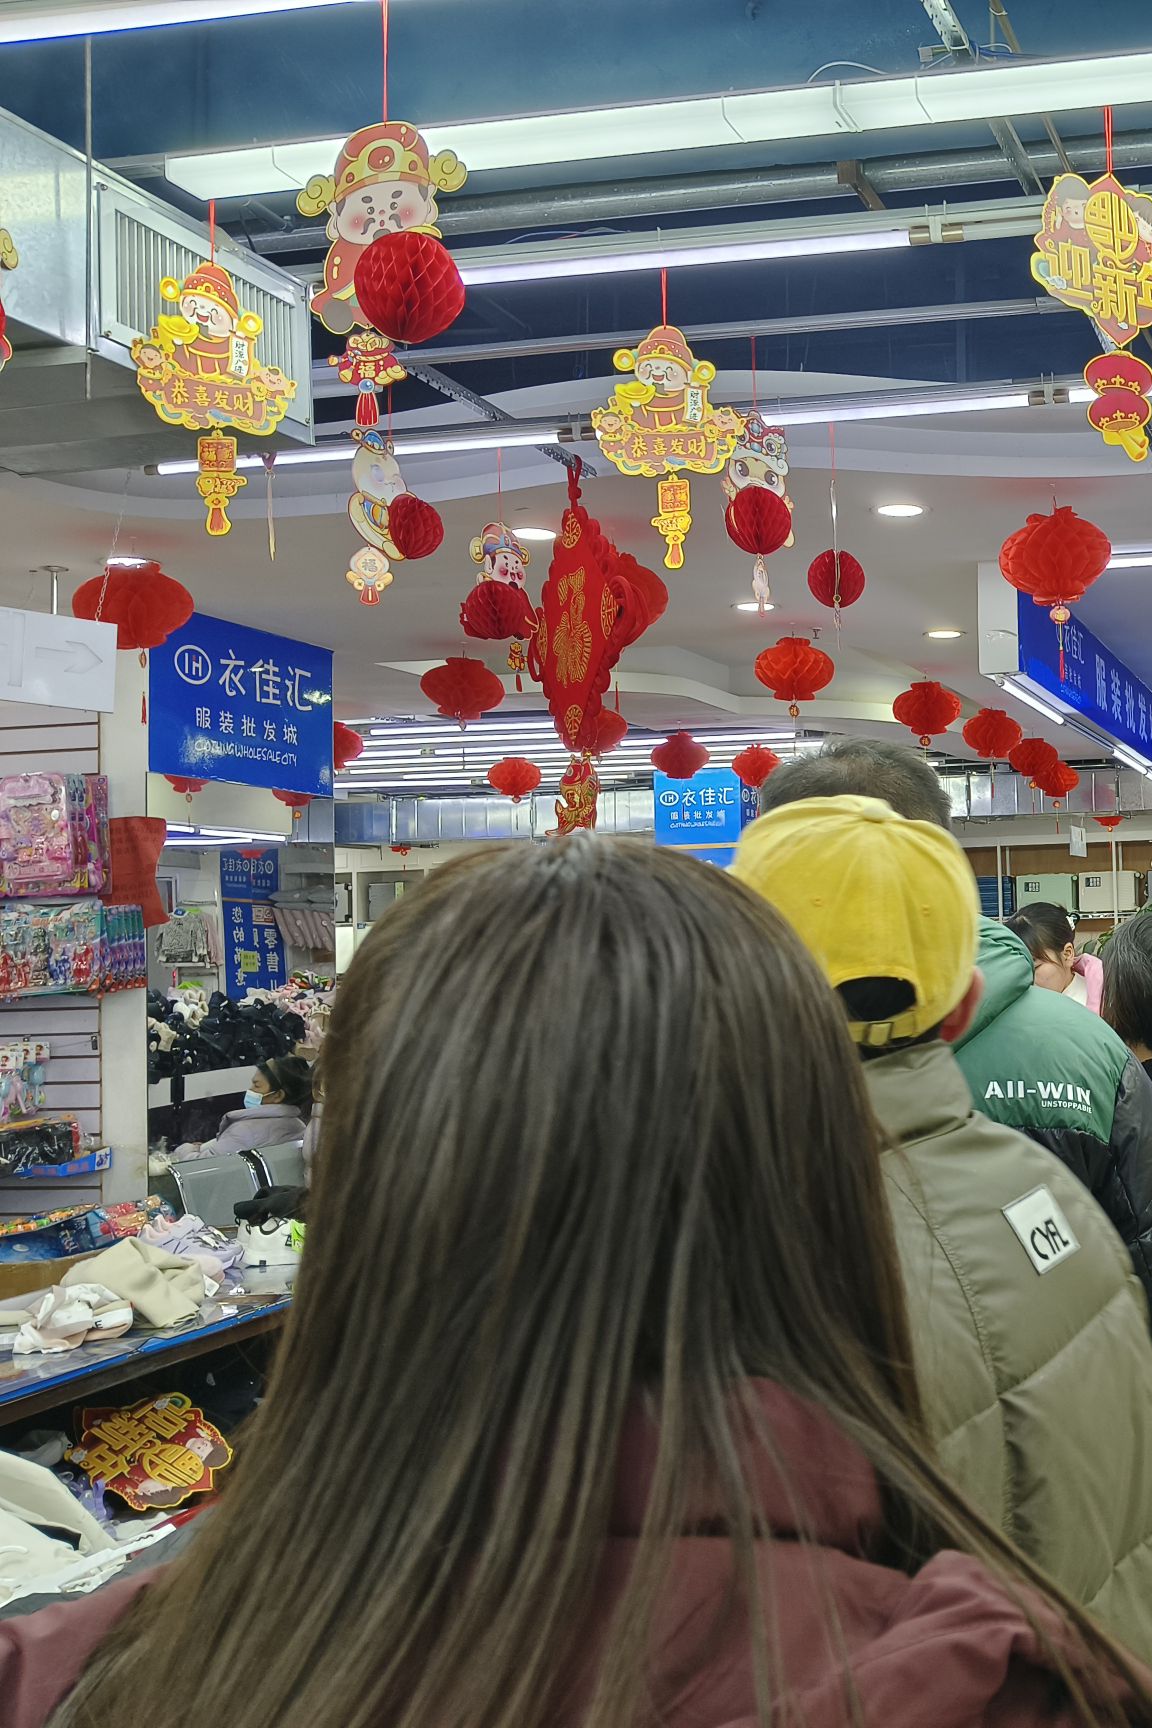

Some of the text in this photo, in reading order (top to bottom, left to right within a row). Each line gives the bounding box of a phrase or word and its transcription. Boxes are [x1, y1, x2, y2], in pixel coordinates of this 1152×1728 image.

[358, 362, 376, 378] 福
[170, 378, 255, 417] 恭喜发财
[630, 437, 708, 459] 恭喜发财
[218, 649, 313, 712] 衣佳汇
[195, 707, 298, 746] 服装批发城
[682, 787, 735, 806] 衣佳汇
